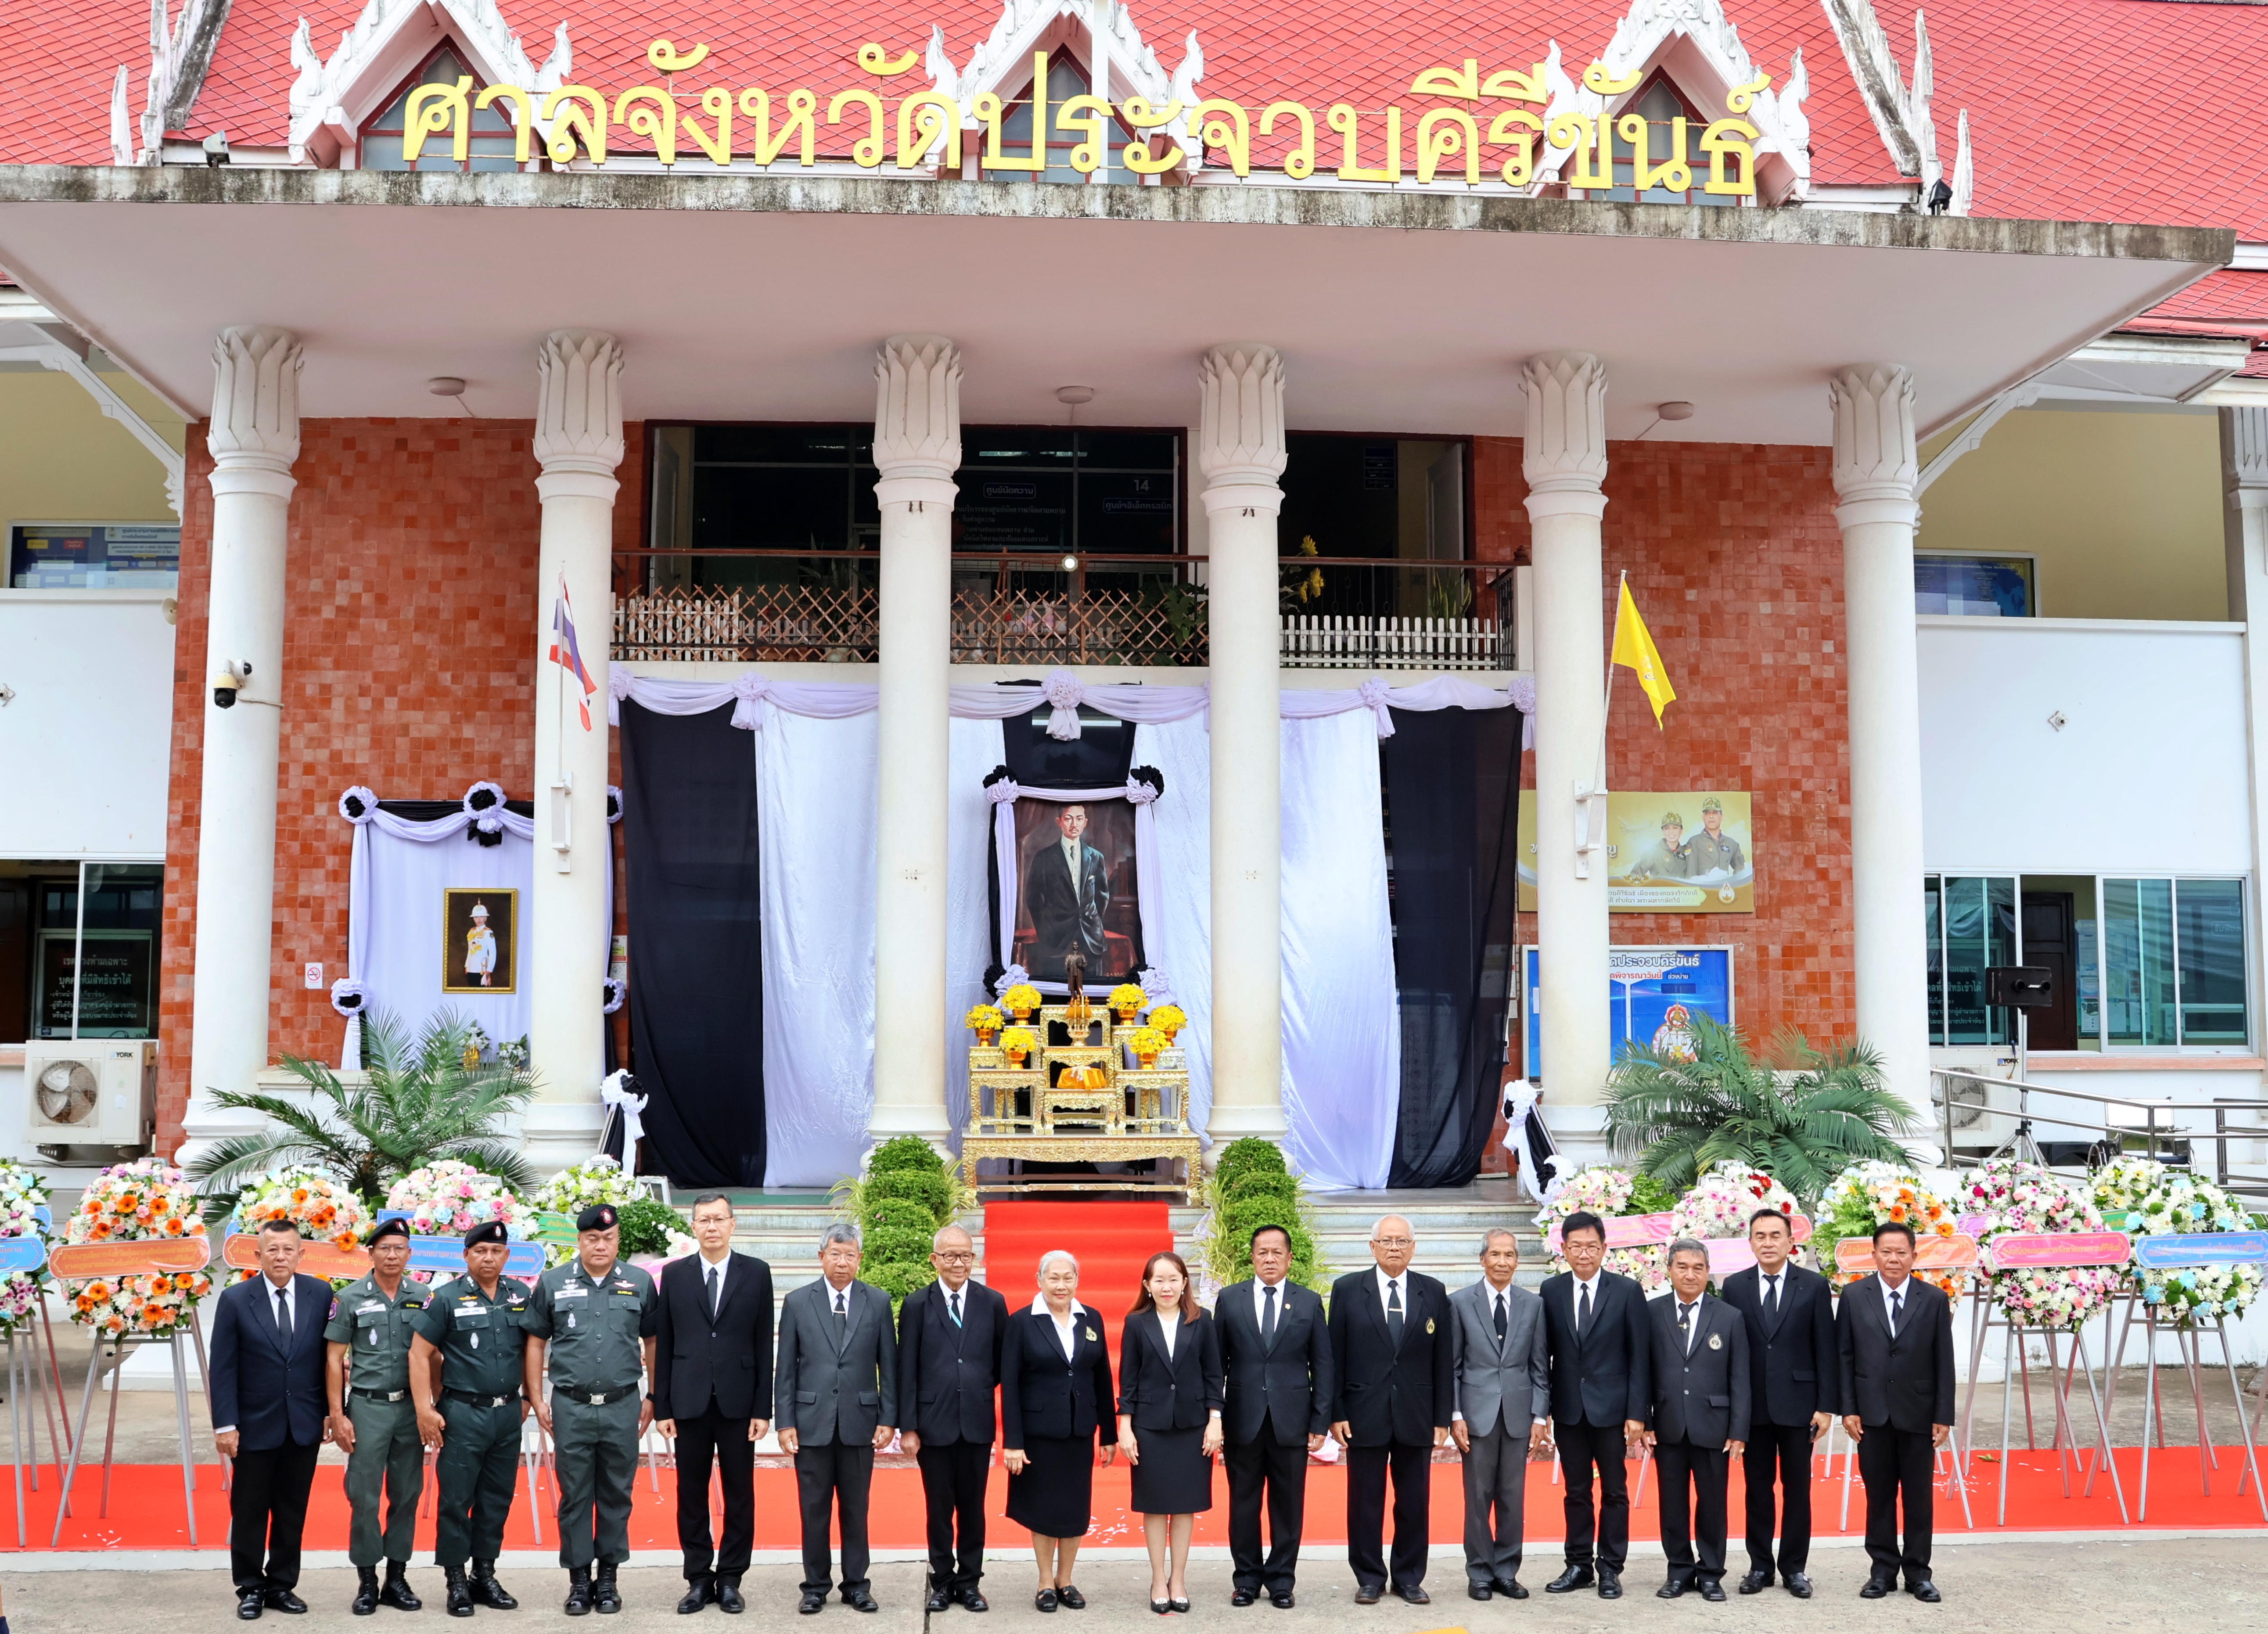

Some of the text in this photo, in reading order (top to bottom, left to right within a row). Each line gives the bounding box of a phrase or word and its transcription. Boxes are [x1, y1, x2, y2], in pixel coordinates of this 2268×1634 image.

[403, 38, 1772, 195] ศาลจังหวัดประจวบคีรีขันธ์
[986, 485, 1034, 496] ศูนย์นัดความ
[1134, 479, 1150, 491] 14
[955, 505, 1066, 515] านบริการของศูนย์นัดความ/ติดตามพยาน
[1105, 501, 1173, 511] ศูนย์ฯอิเล็กทรอนิก
[63, 954, 128, 966] เขตวงห้ามเฉพาะ
[1610, 953, 1701, 967] ดประจวบคีรีขันธ์
[1610, 969, 1662, 979] ดพิจารณาวันนี้
